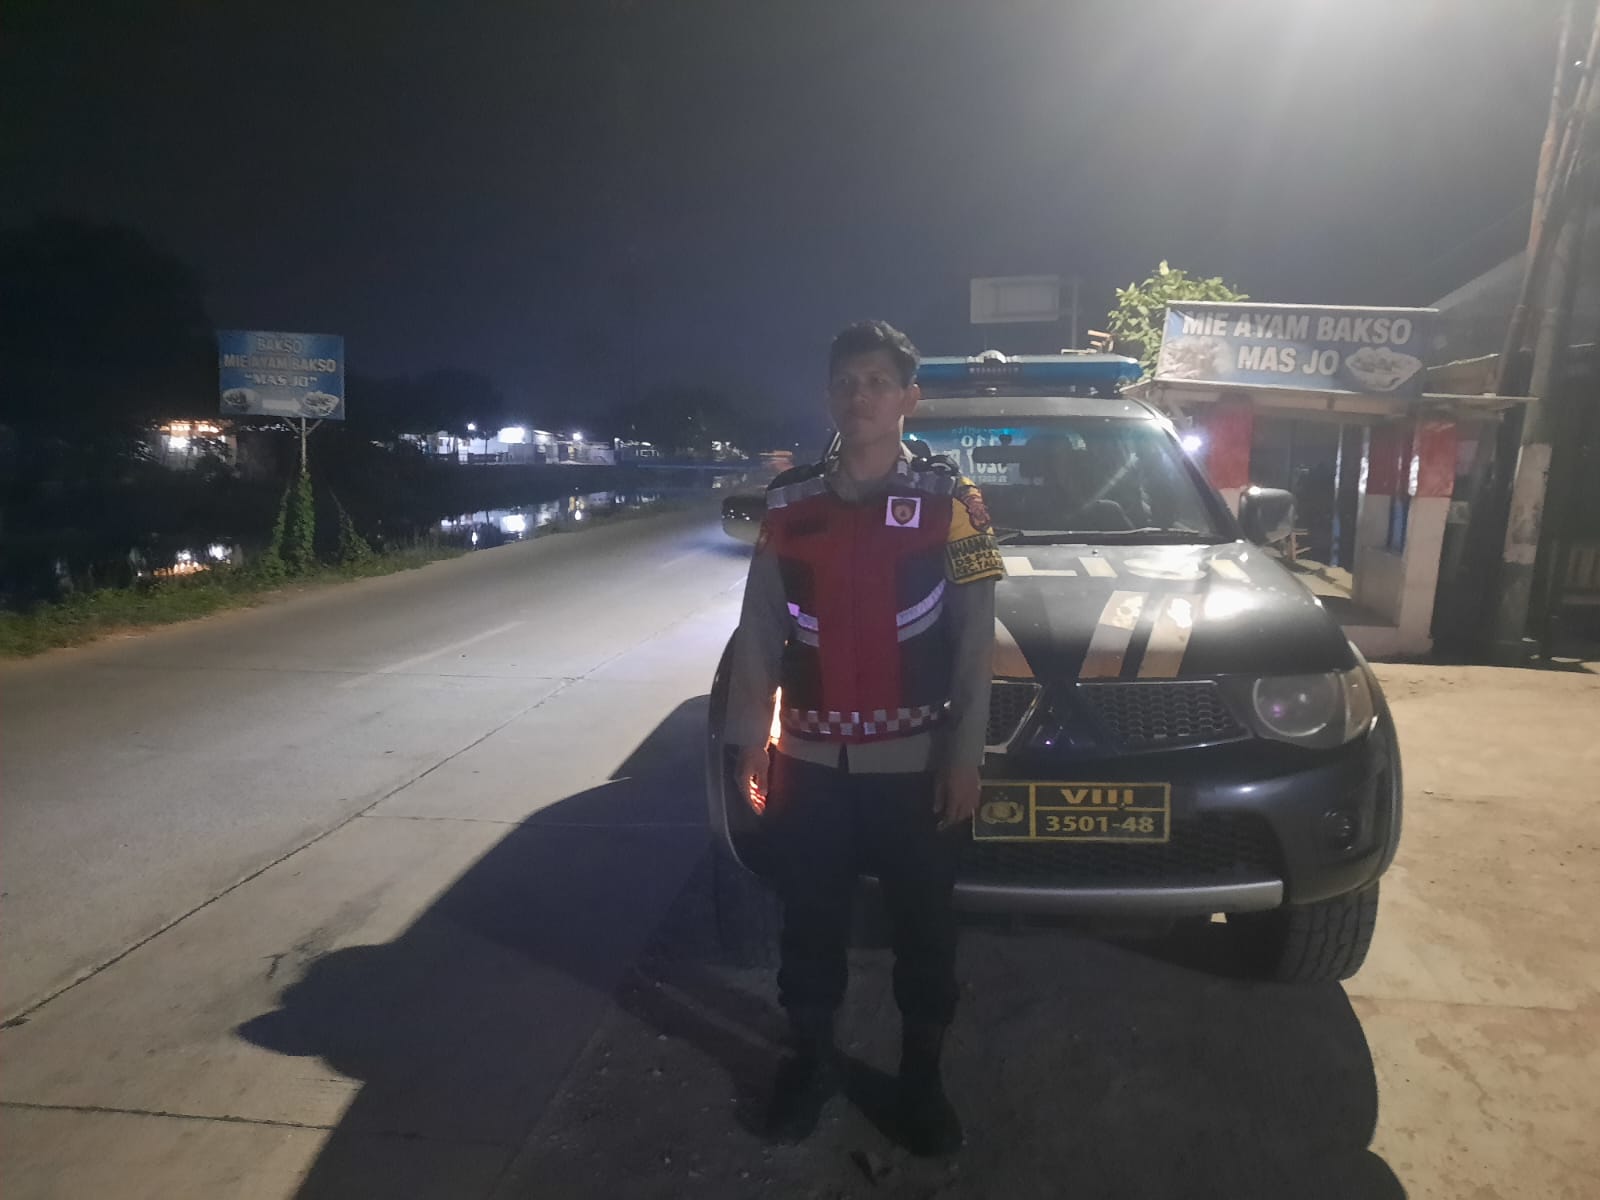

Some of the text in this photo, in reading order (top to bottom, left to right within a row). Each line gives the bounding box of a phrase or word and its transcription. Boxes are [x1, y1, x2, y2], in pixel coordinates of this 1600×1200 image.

[1182, 312, 1413, 345] MIE AYAM BAKSO
[257, 338, 304, 353] BAKSO
[223, 354, 337, 373] MIE AYAM BAKSO
[1237, 346, 1341, 375] MAS JO
[1001, 556, 1251, 581] LISI
[1060, 788, 1134, 805] VIII
[1045, 815, 1155, 833] 3501-48
